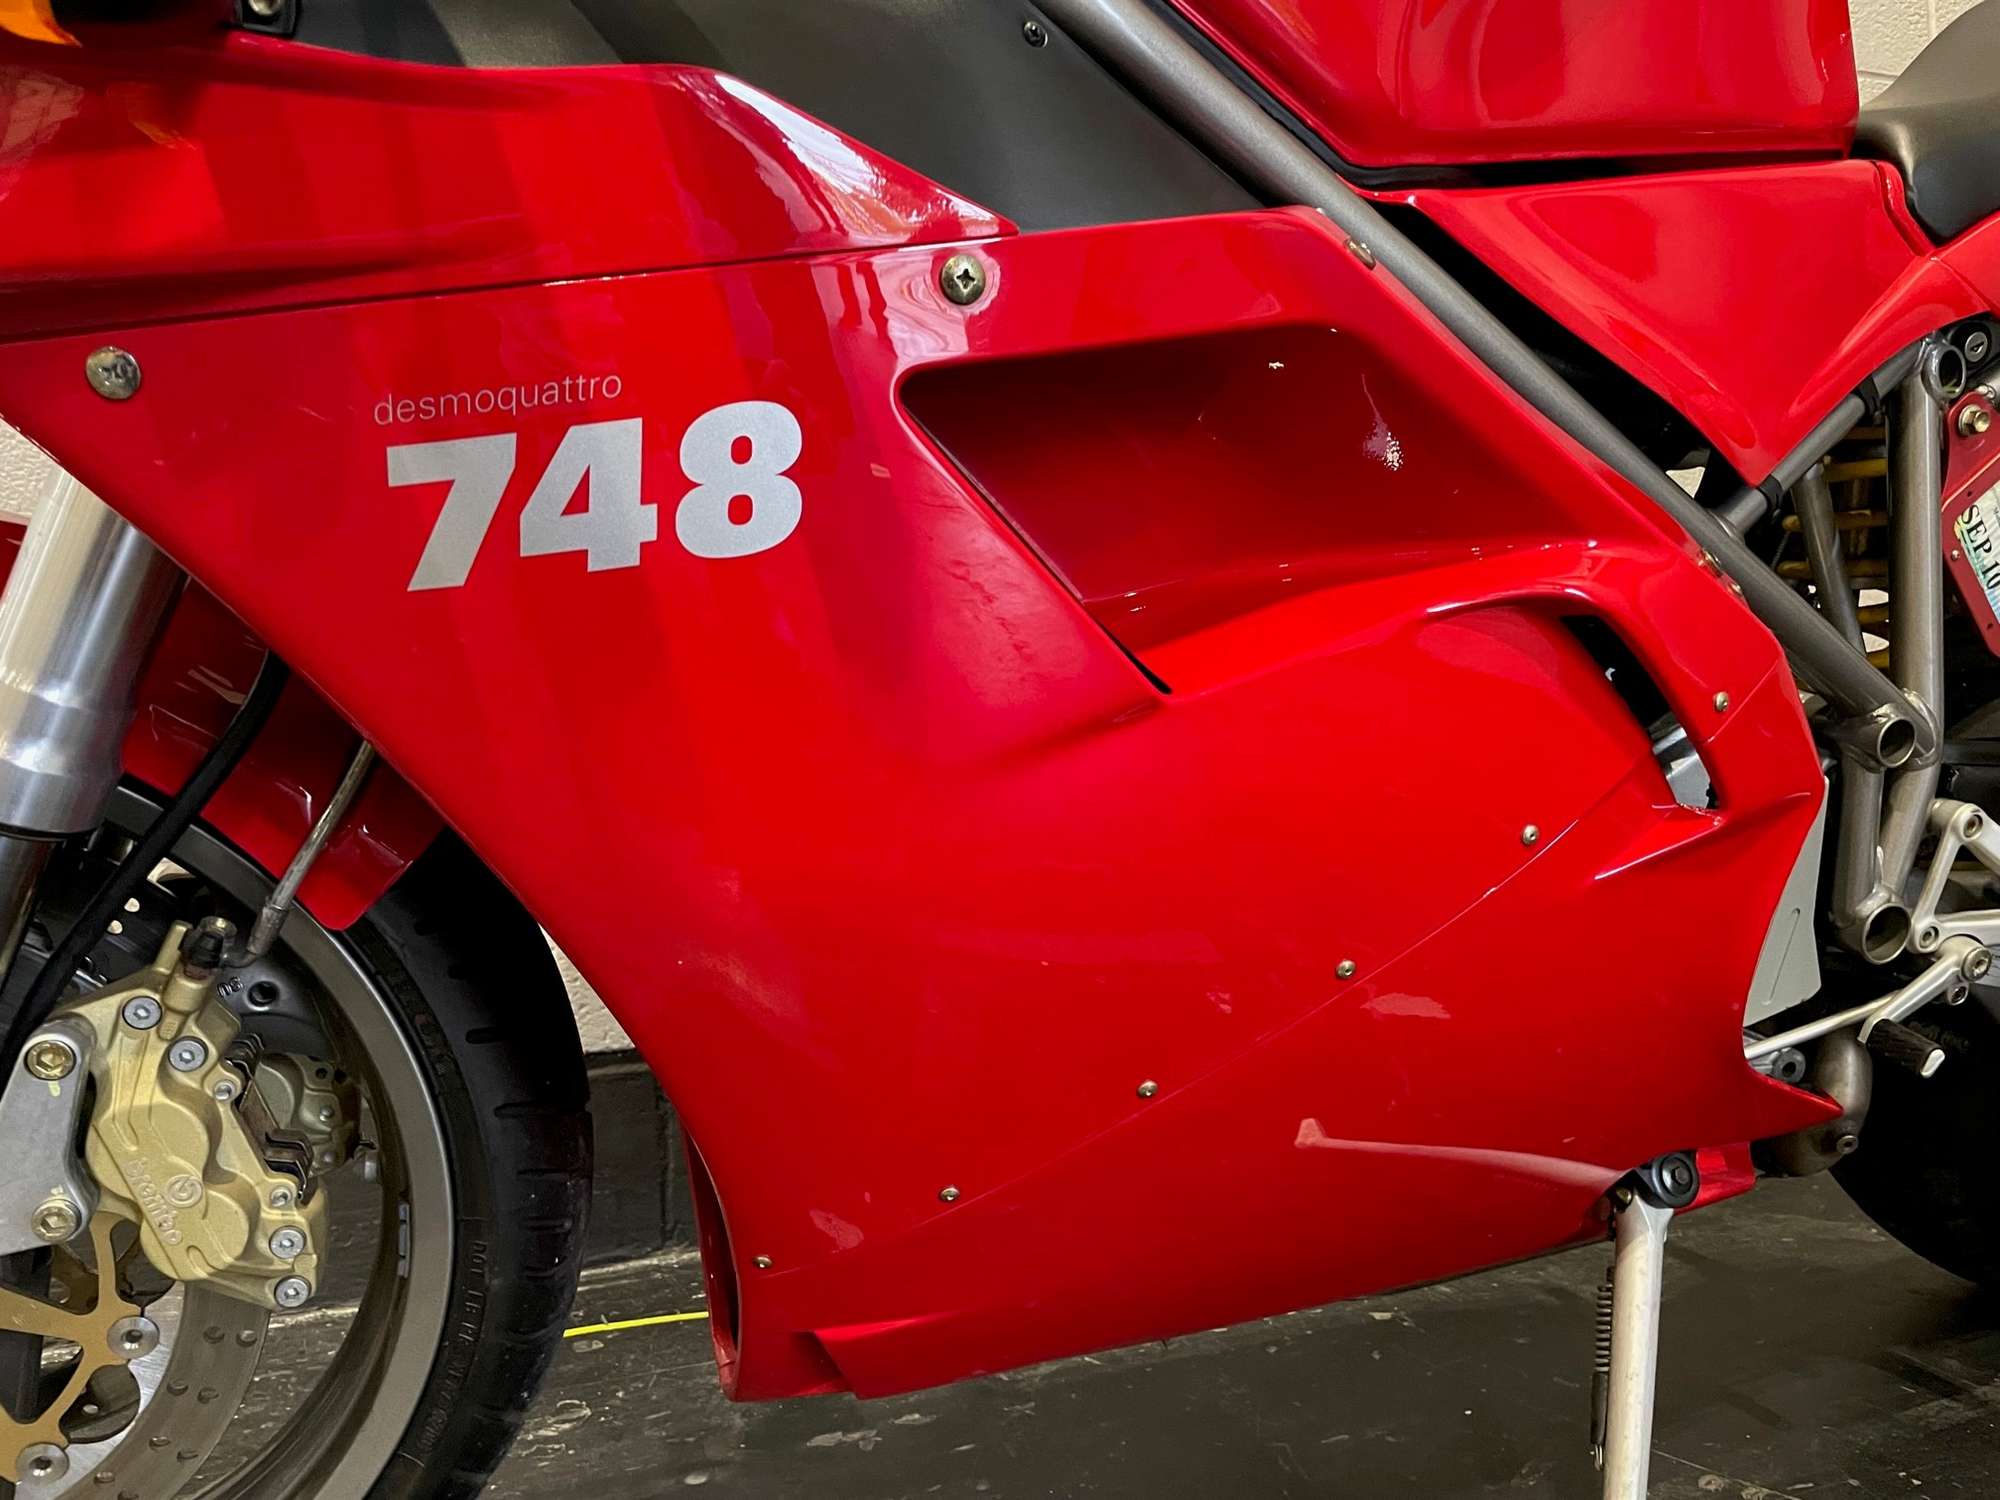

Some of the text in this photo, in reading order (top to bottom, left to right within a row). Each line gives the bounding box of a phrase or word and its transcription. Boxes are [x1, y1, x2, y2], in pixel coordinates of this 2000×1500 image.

[374, 374, 622, 425] desmoquattro
[387, 400, 803, 592] 748
[1962, 504, 1993, 553] SEP
